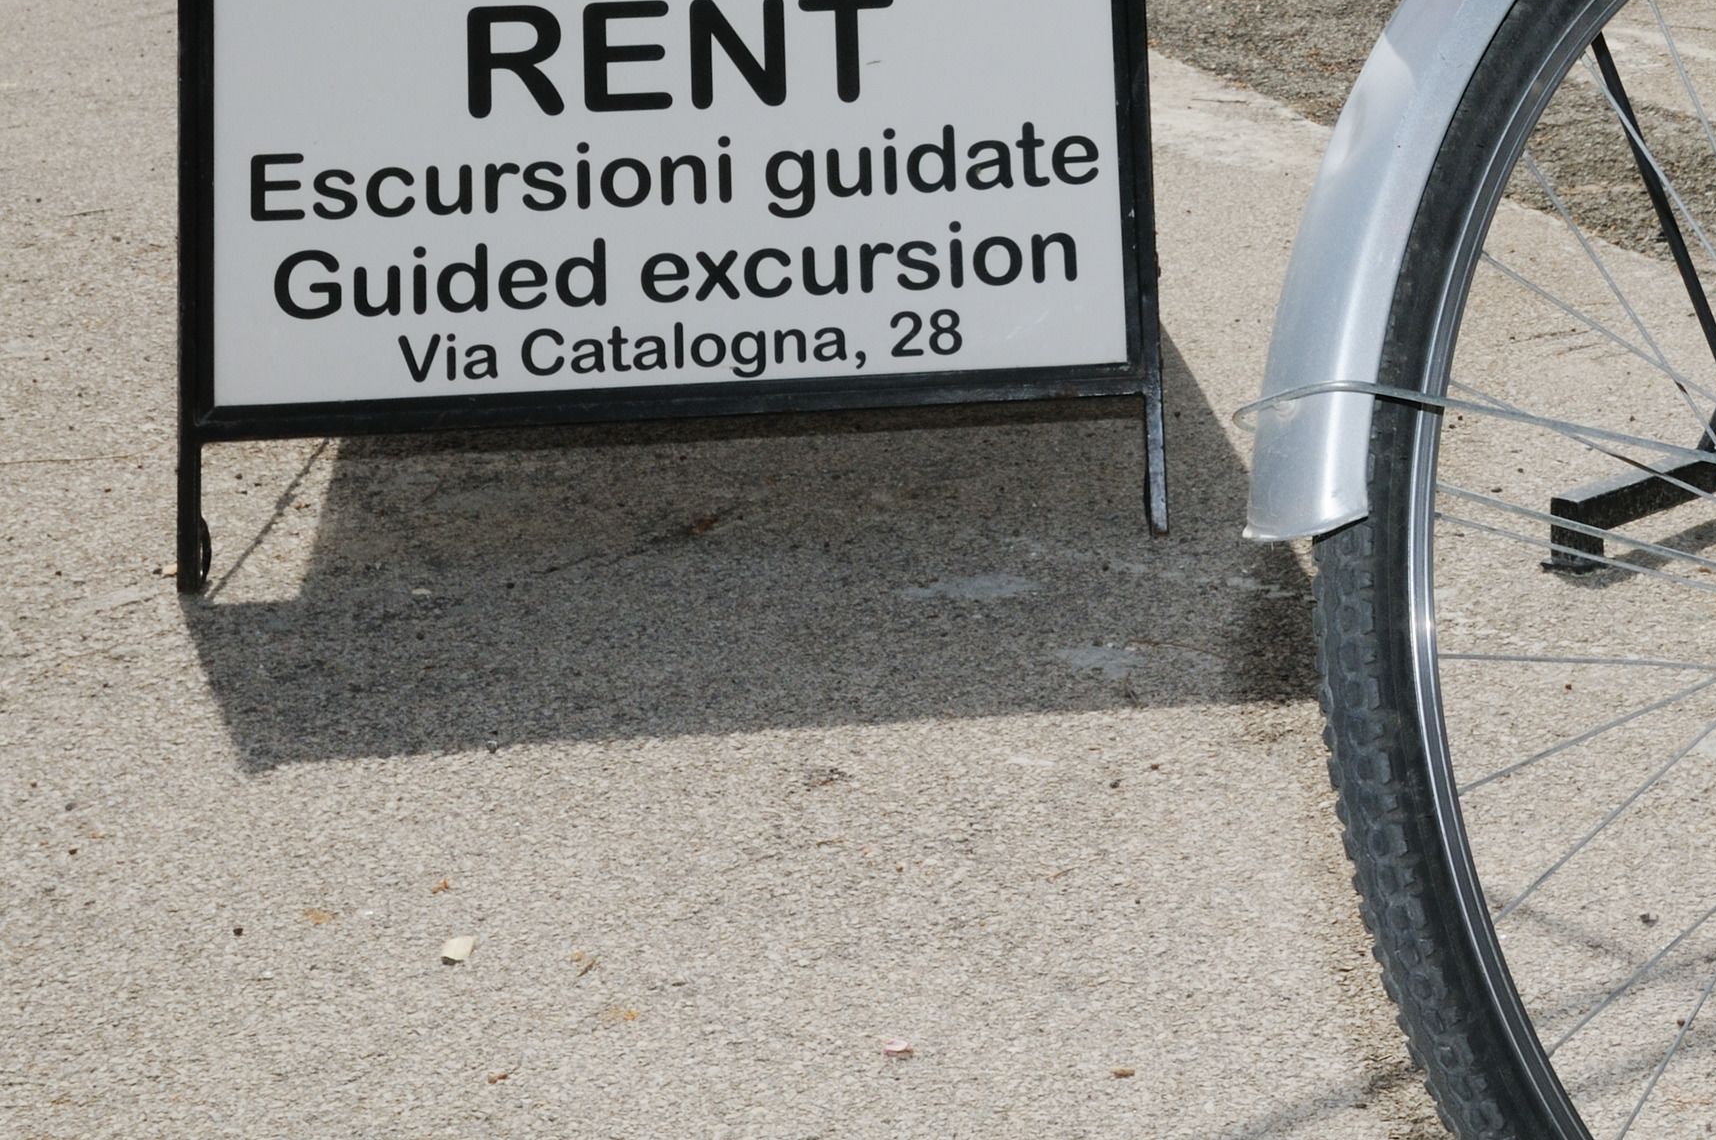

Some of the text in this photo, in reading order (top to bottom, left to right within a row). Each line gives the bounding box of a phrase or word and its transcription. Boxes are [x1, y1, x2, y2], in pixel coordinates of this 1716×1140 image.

[251, 122, 1099, 221] Escursioni guidate
[274, 221, 1077, 319] Guided excursion
[398, 308, 963, 382] Via Catalogna, 28
